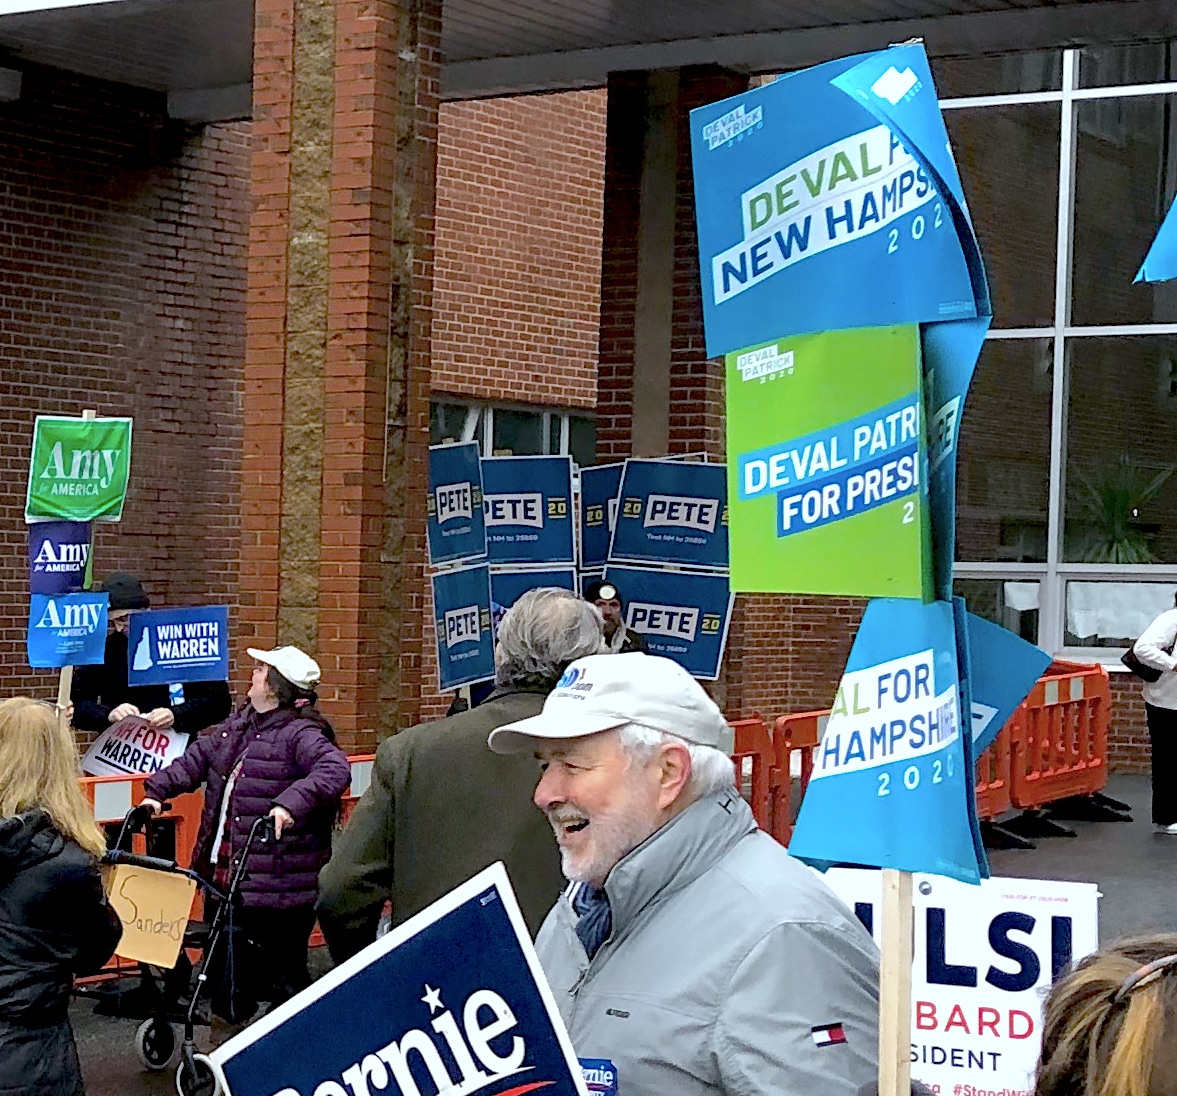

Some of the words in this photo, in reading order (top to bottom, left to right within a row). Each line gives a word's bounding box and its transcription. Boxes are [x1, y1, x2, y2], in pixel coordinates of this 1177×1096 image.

[749, 142, 883, 232] DEVAL
[721, 214, 812, 294] NEW
[825, 165, 934, 241] HAMPS
[888, 202, 943, 255] 202
[739, 348, 777, 368] DEVAL
[744, 354, 792, 378] PATRICK
[744, 435, 849, 495] DEVAL
[853, 401, 920, 462] PATRI
[39, 440, 122, 489] Amy
[51, 483, 100, 496] AMERICA
[438, 488, 470, 516] PETE
[782, 483, 841, 531] FOR
[846, 451, 920, 511] PRESI
[547, 502, 567, 515] 20
[586, 509, 603, 522] 20
[624, 502, 642, 514] 20
[649, 500, 713, 526] PETE
[33, 539, 90, 568] Amy
[45, 563, 81, 572] AMERICA
[35, 599, 104, 634] Amy
[157, 623, 183, 640] WIN
[184, 621, 219, 639] WITH
[447, 611, 478, 641] PETE
[630, 607, 694, 634] PETE
[701, 618, 720, 630] 20
[157, 637, 219, 660] WARREN
[877, 663, 931, 709] FOR
[100, 736, 164, 774] WARREN
[132, 725, 170, 758] FOR
[120, 874, 185, 941] Sanders
[915, 1000, 1035, 1041] BARD
[910, 1043, 1002, 1071] SIDENT
